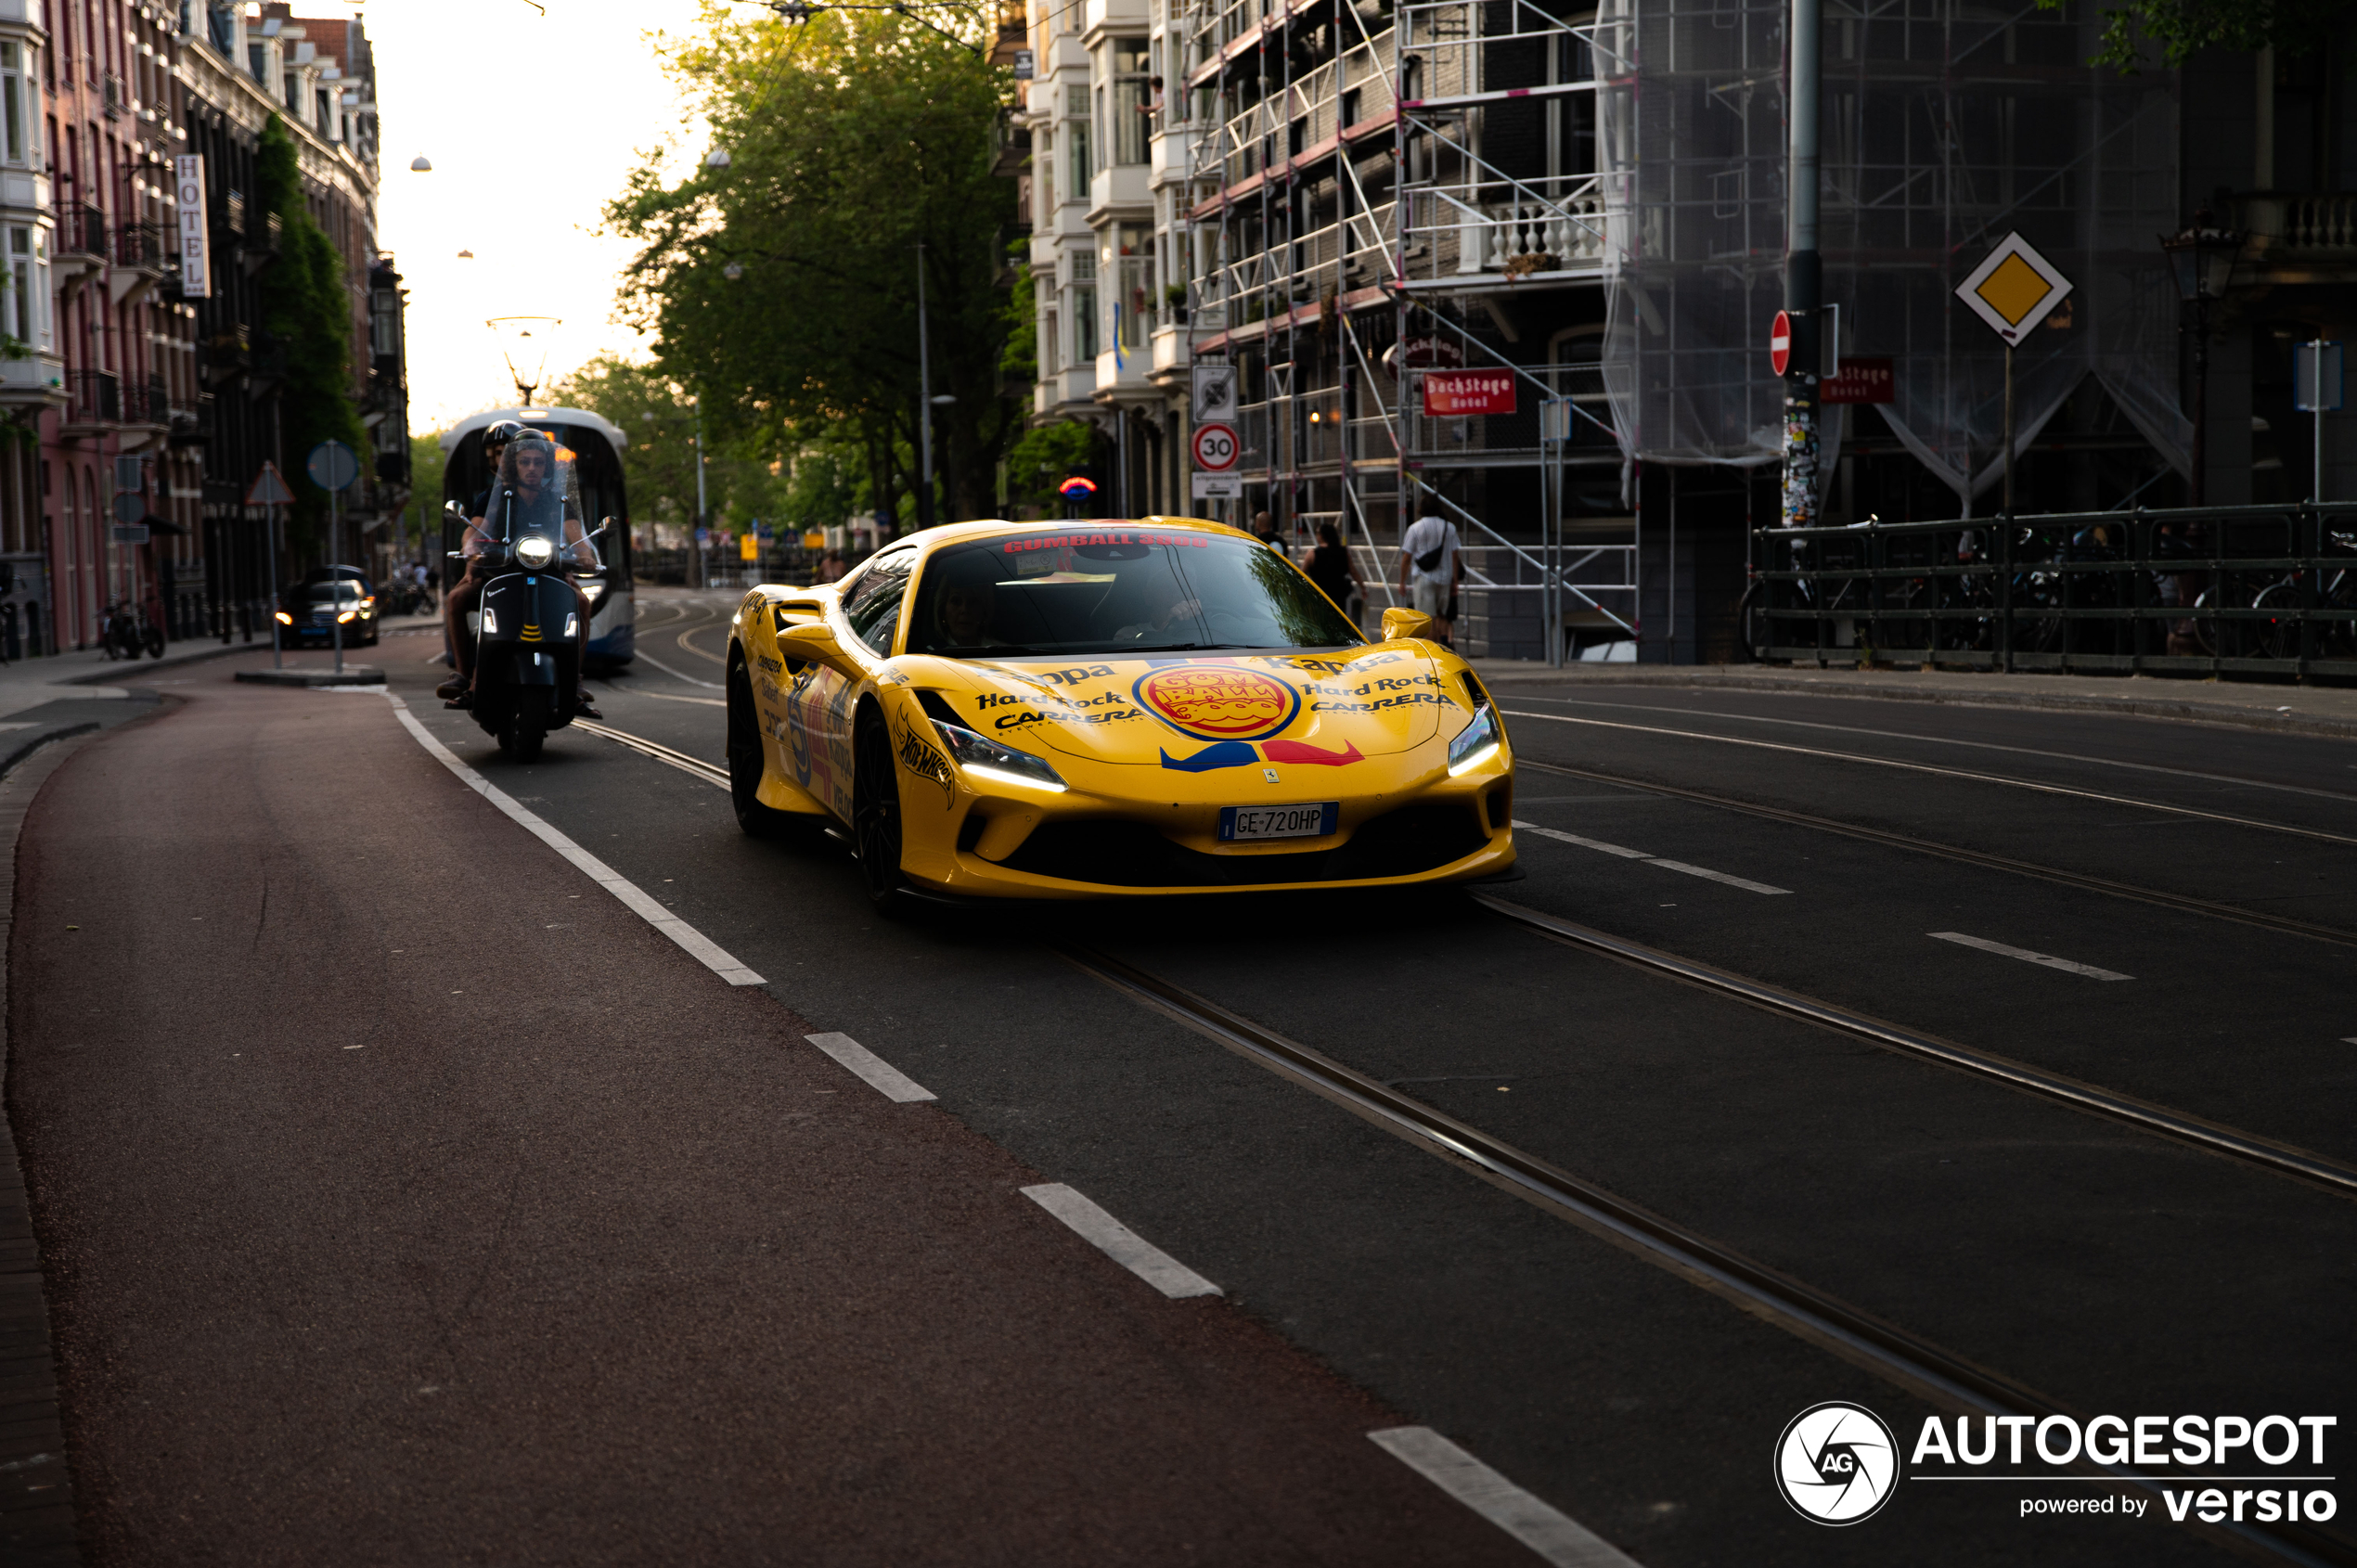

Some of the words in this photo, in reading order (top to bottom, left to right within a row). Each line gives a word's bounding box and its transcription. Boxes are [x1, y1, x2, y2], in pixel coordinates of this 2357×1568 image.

[178, 157, 202, 285] HOTEL
[1203, 439, 1232, 456] 30
[1003, 533, 1134, 554] GUMBALL
[1139, 533, 1208, 548] 3000
[757, 654, 782, 675] CARRERA
[1262, 652, 1407, 676] Kappa
[1300, 683, 1371, 696] Hard
[1373, 673, 1447, 690] Rock
[975, 693, 1050, 711] Hard
[1059, 691, 1127, 711] Rock
[1309, 693, 1457, 712] CARRERA
[995, 708, 1146, 729] CARRERA
[998, 720, 1063, 737] EYEWEAR
